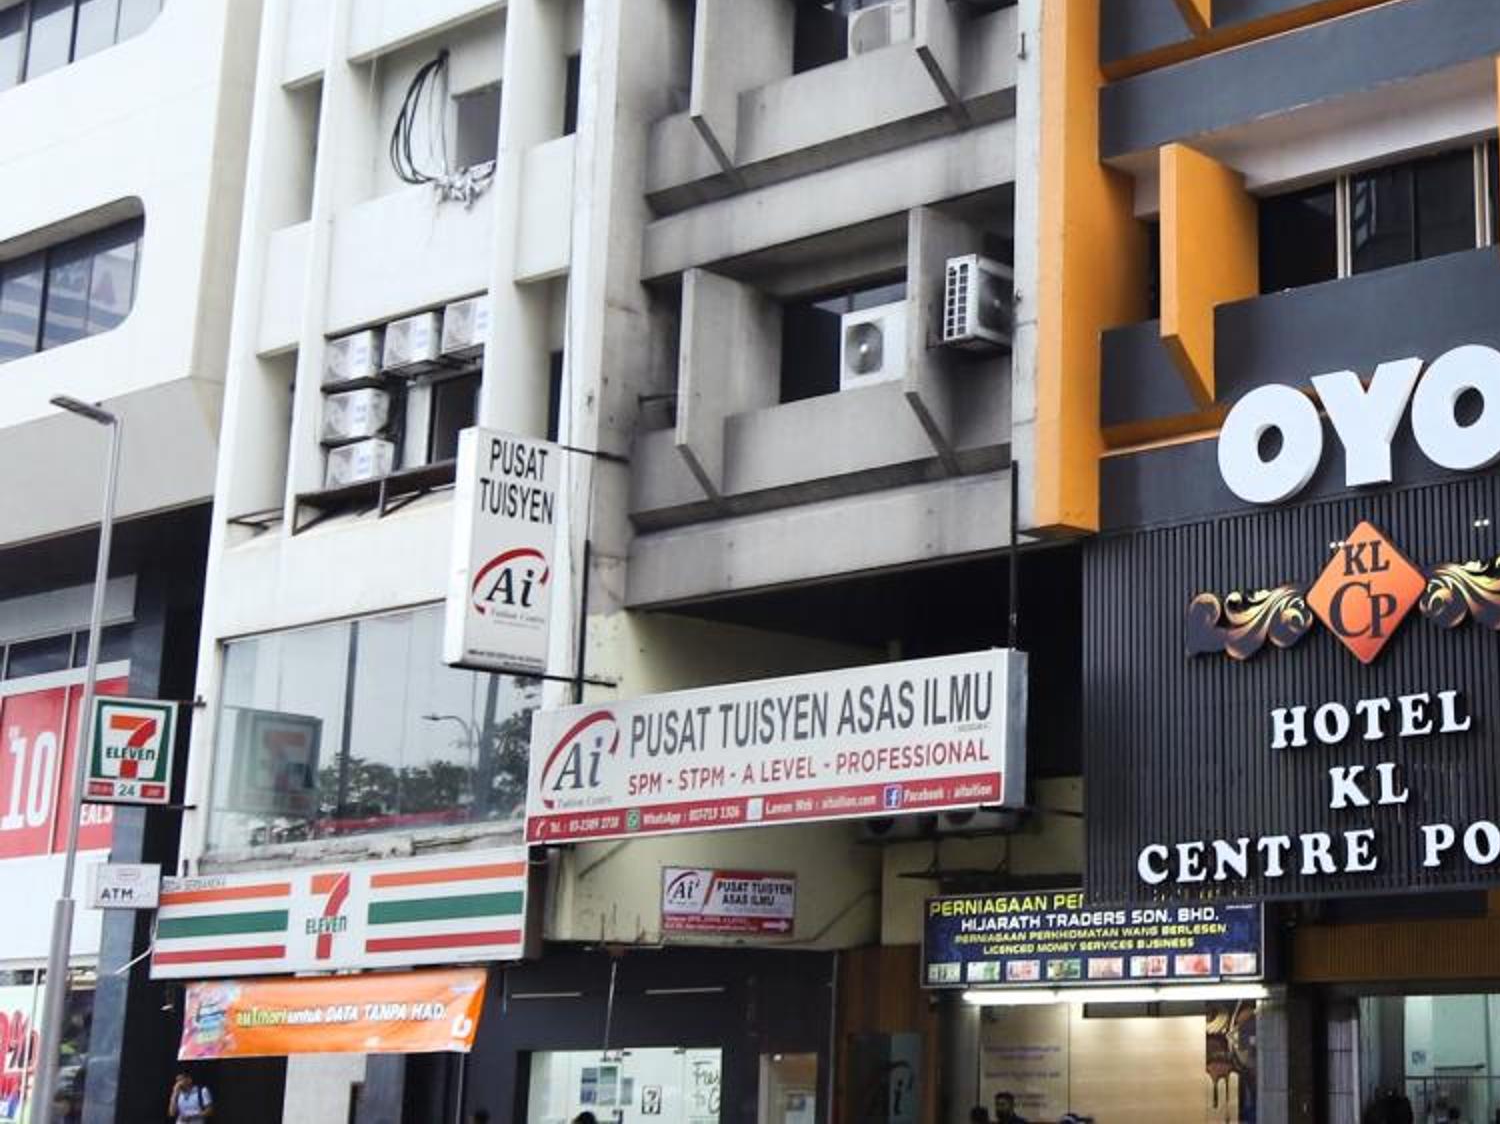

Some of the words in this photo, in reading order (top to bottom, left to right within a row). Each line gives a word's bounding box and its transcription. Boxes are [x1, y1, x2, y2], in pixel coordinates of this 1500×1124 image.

[489, 438, 548, 482] PUSAT
[480, 477, 555, 524] TUISYEN
[1342, 540, 1390, 576] KL
[486, 567, 535, 608] Ai
[1328, 581, 1397, 640] CP
[630, 706, 711, 759] PUSAT
[719, 691, 828, 749] TUISYEN
[837, 680, 914, 736] ASAS
[923, 671, 993, 726] ILMU
[1270, 689, 1472, 750] HOTEL
[110, 715, 157, 779] 7
[552, 735, 603, 791] Ai
[628, 774, 662, 796] SPM
[679, 766, 725, 790] STPM
[742, 763, 755, 784] A
[760, 756, 816, 783] LEVEL
[836, 738, 989, 776] PROFESSIONAL
[118, 784, 135, 796] 24
[1328, 762, 1409, 809] KL
[1137, 829, 1378, 884] CENTRE
[101, 888, 133, 899] ATM
[717, 881, 749, 893] PUSAT
[752, 883, 793, 895] TUISYEN
[930, 896, 1047, 917] PERNIAGAAN
[310, 872, 350, 959] 7
[962, 914, 1041, 932] HIJARATH
[1046, 910, 1125, 927] TRADERS
[1131, 909, 1173, 924] SDN.
[1177, 907, 1219, 922] BHD.
[365, 1004, 408, 1021] TANPA
